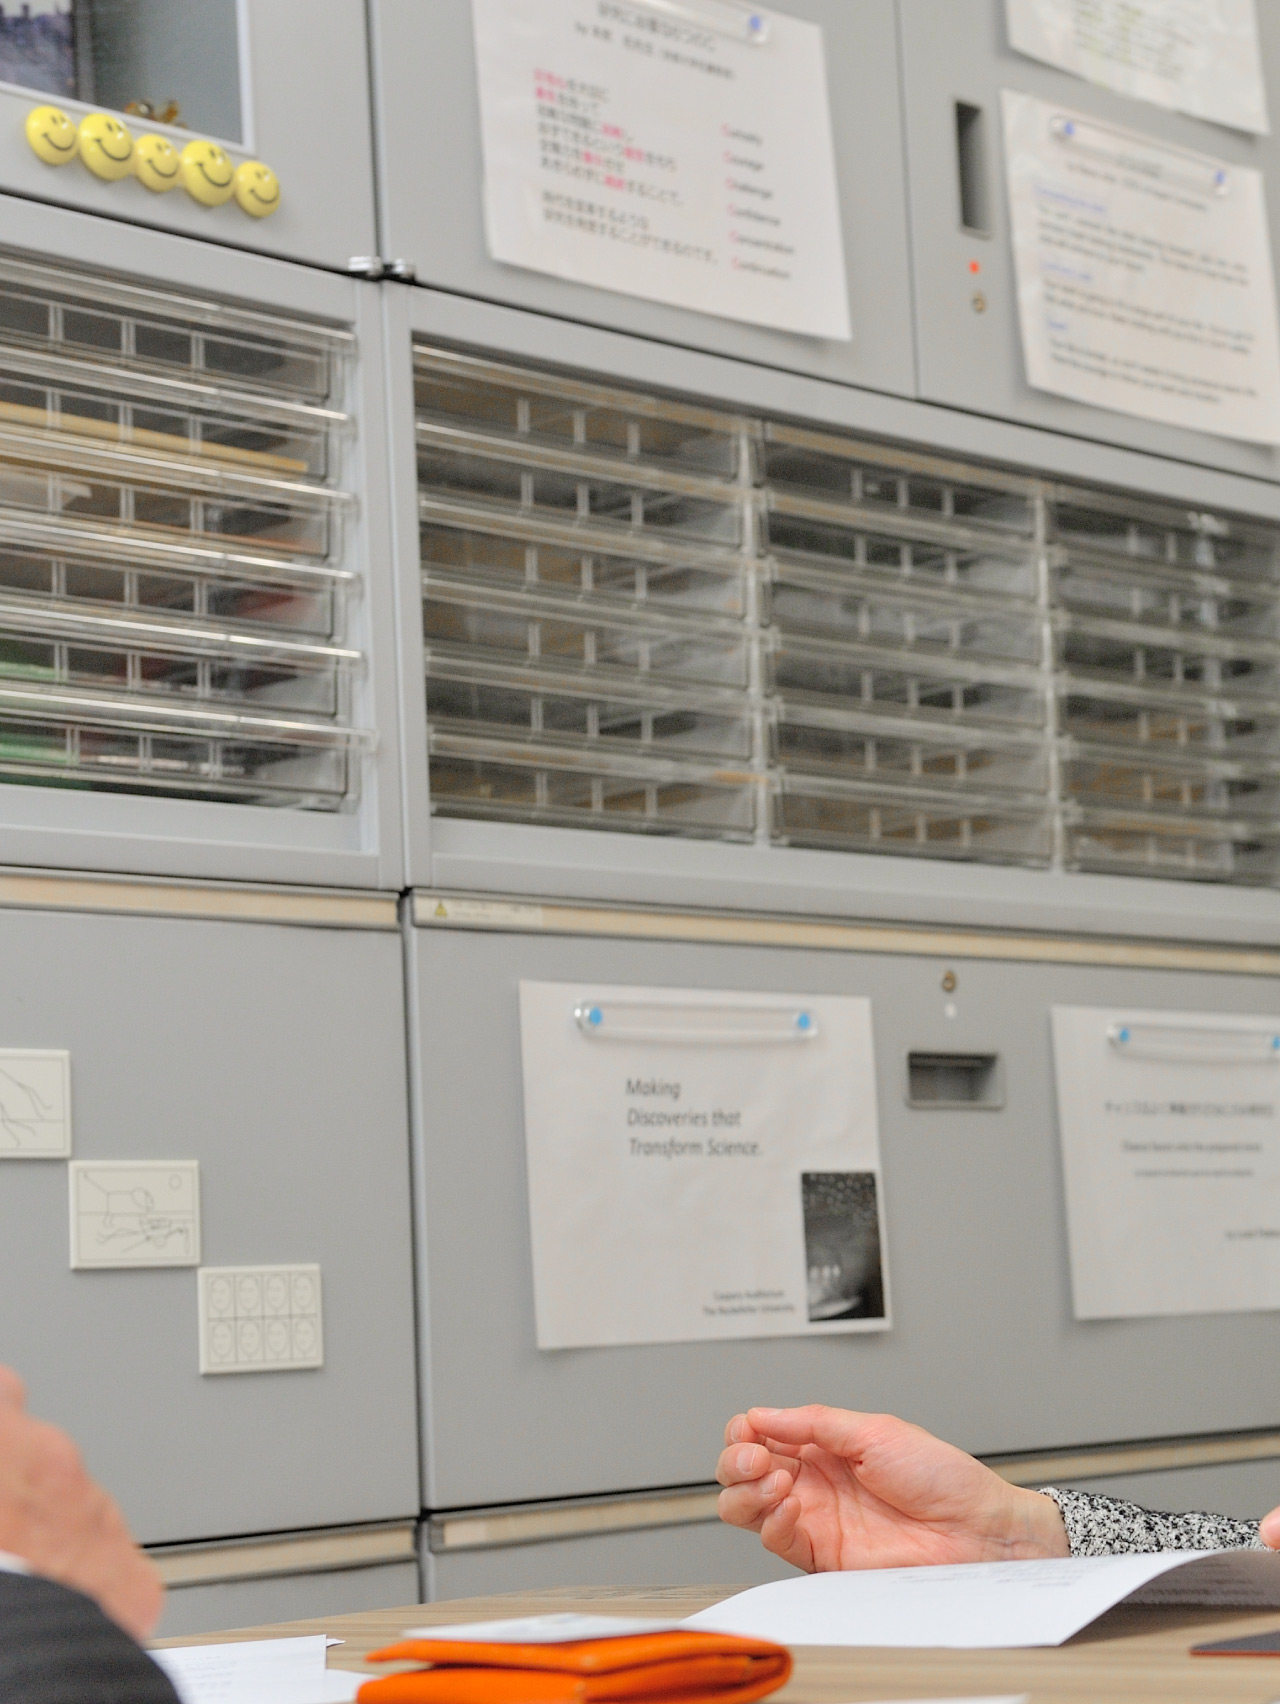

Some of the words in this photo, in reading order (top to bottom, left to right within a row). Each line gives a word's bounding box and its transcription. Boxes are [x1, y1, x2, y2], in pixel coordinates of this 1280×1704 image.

[625, 1077, 682, 1101] Making
[627, 1106, 709, 1127] Discoveries
[711, 1107, 742, 1127] that
[629, 1136, 703, 1161] Transform
